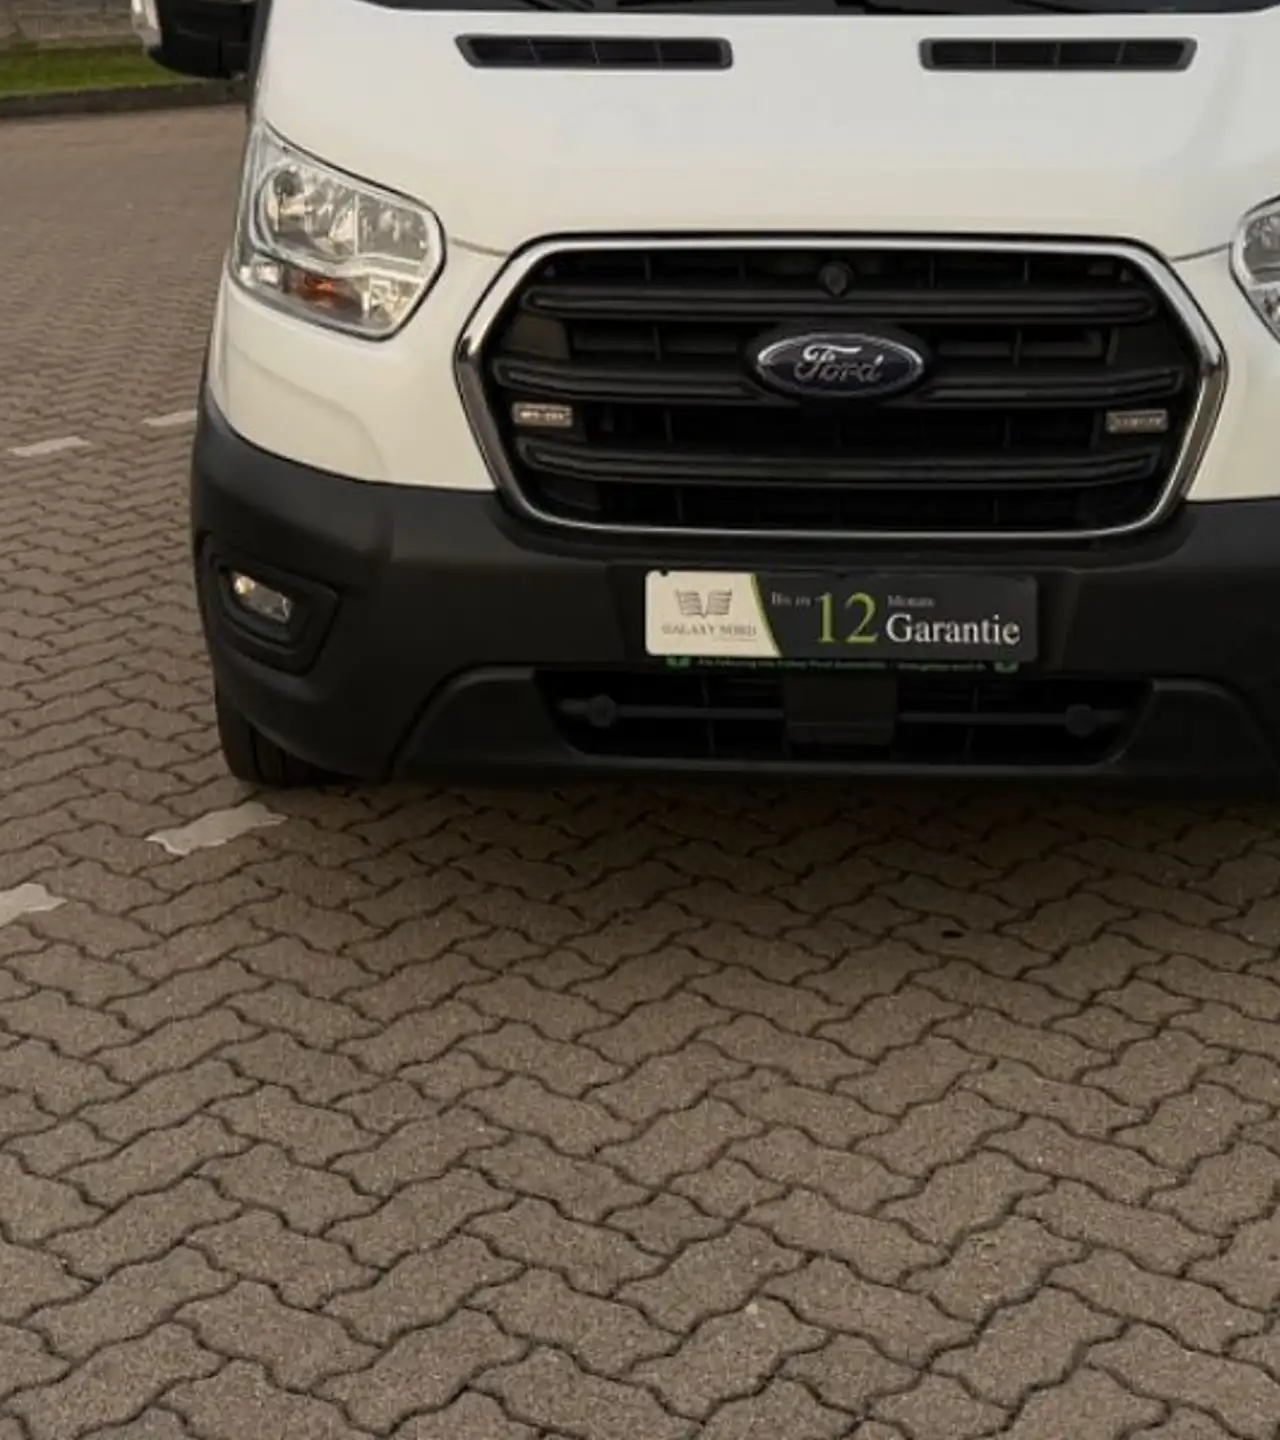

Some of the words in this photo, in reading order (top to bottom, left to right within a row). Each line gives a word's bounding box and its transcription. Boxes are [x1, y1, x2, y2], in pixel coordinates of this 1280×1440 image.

[794, 343, 884, 382] Ford
[817, 592, 879, 643] 12
[885, 613, 1021, 645] Garantie
